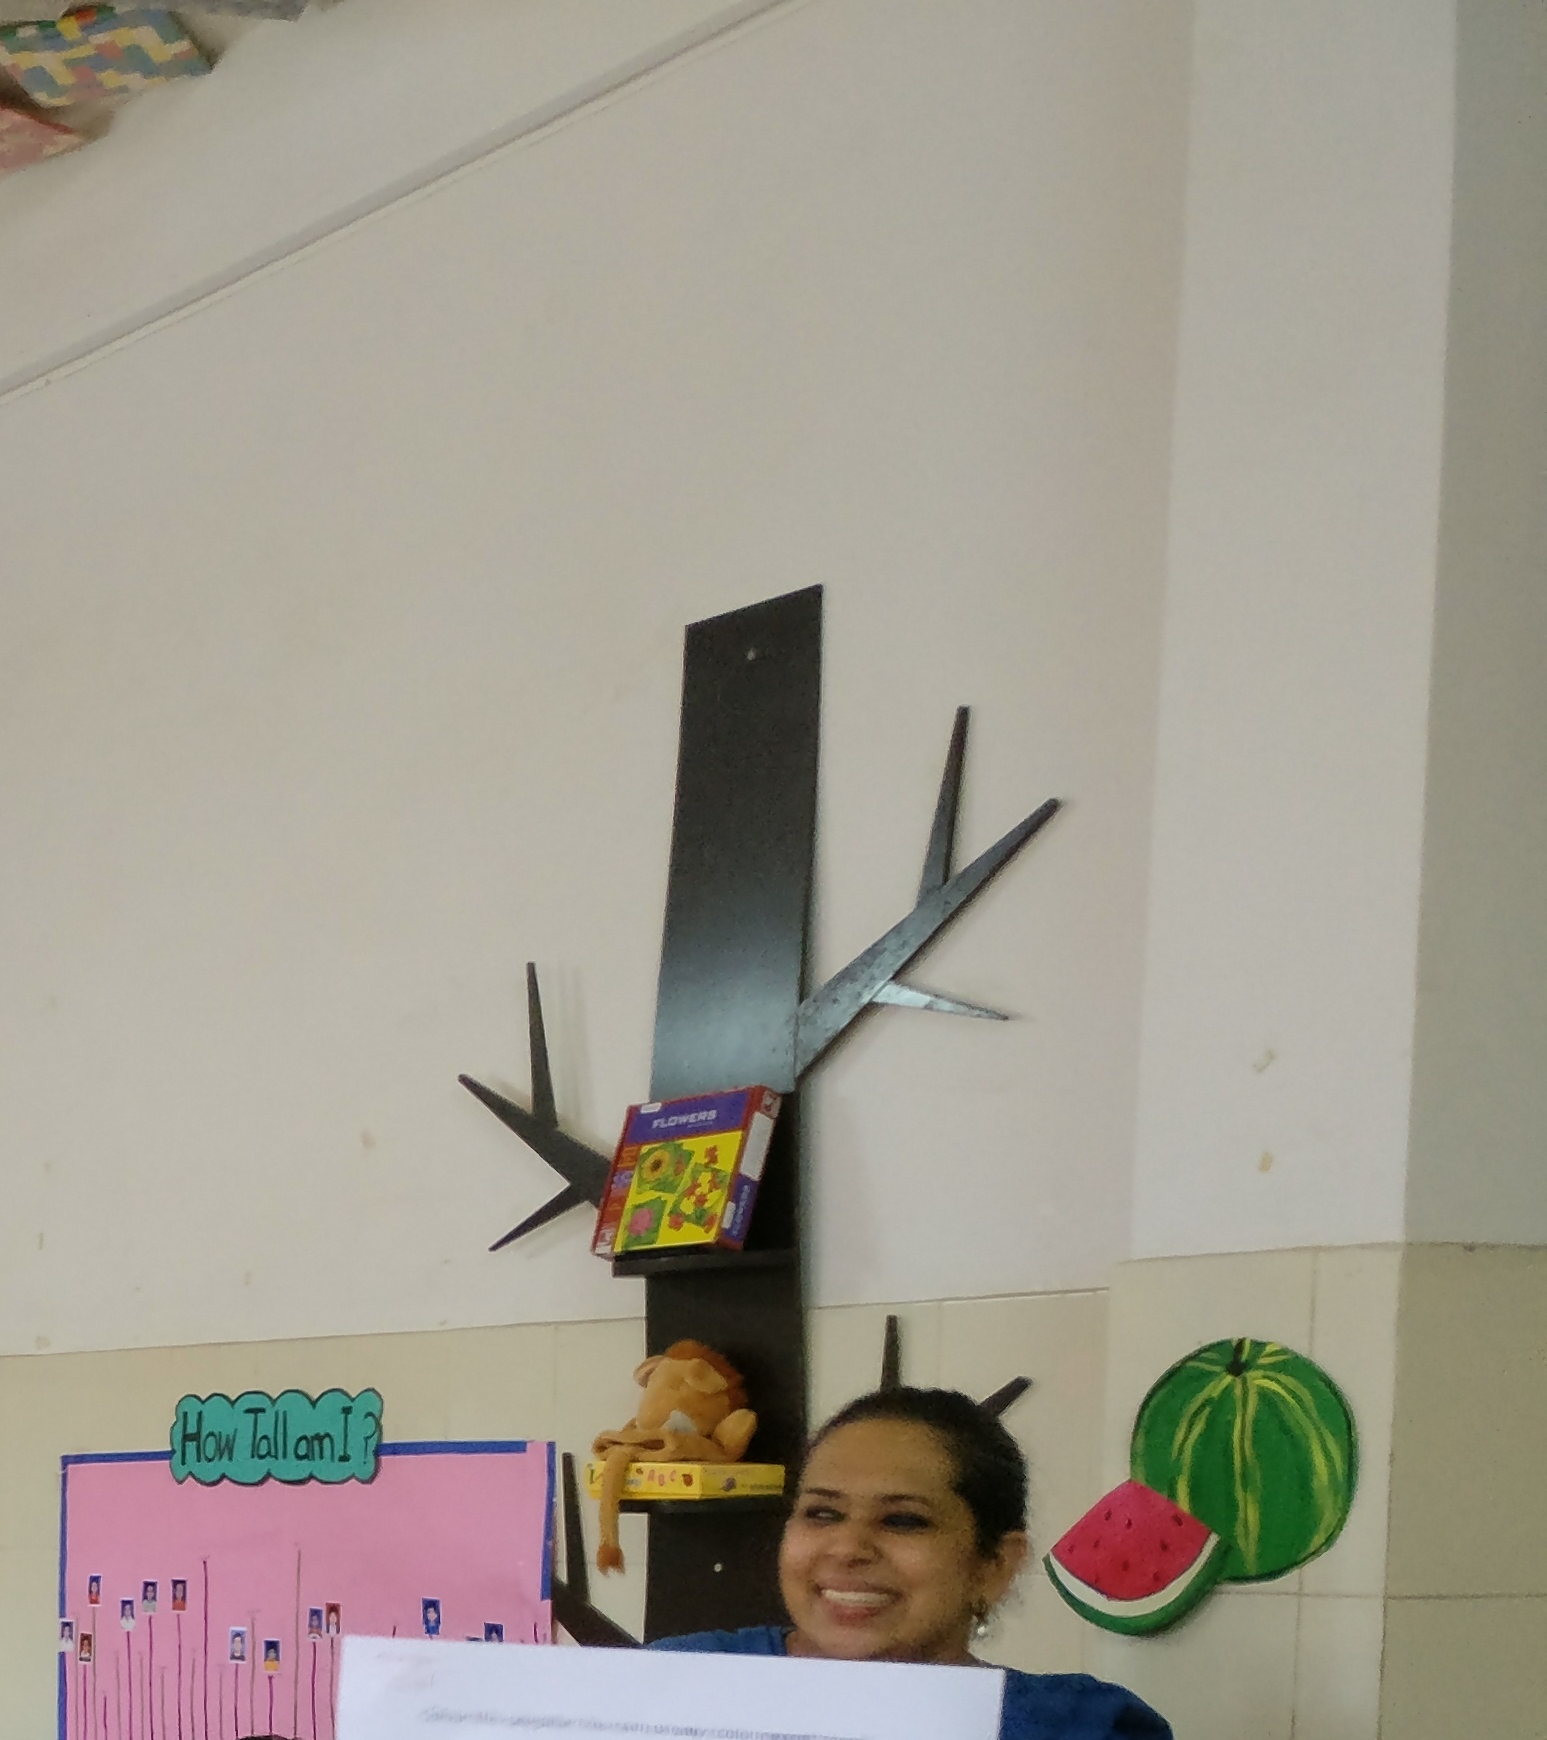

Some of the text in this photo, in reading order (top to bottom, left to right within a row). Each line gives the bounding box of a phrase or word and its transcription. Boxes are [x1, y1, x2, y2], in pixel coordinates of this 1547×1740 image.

[651, 1109, 718, 1129] FLOWERS
[180, 1410, 237, 1466] How
[243, 1407, 288, 1460] Tall
[293, 1431, 335, 1462] am
